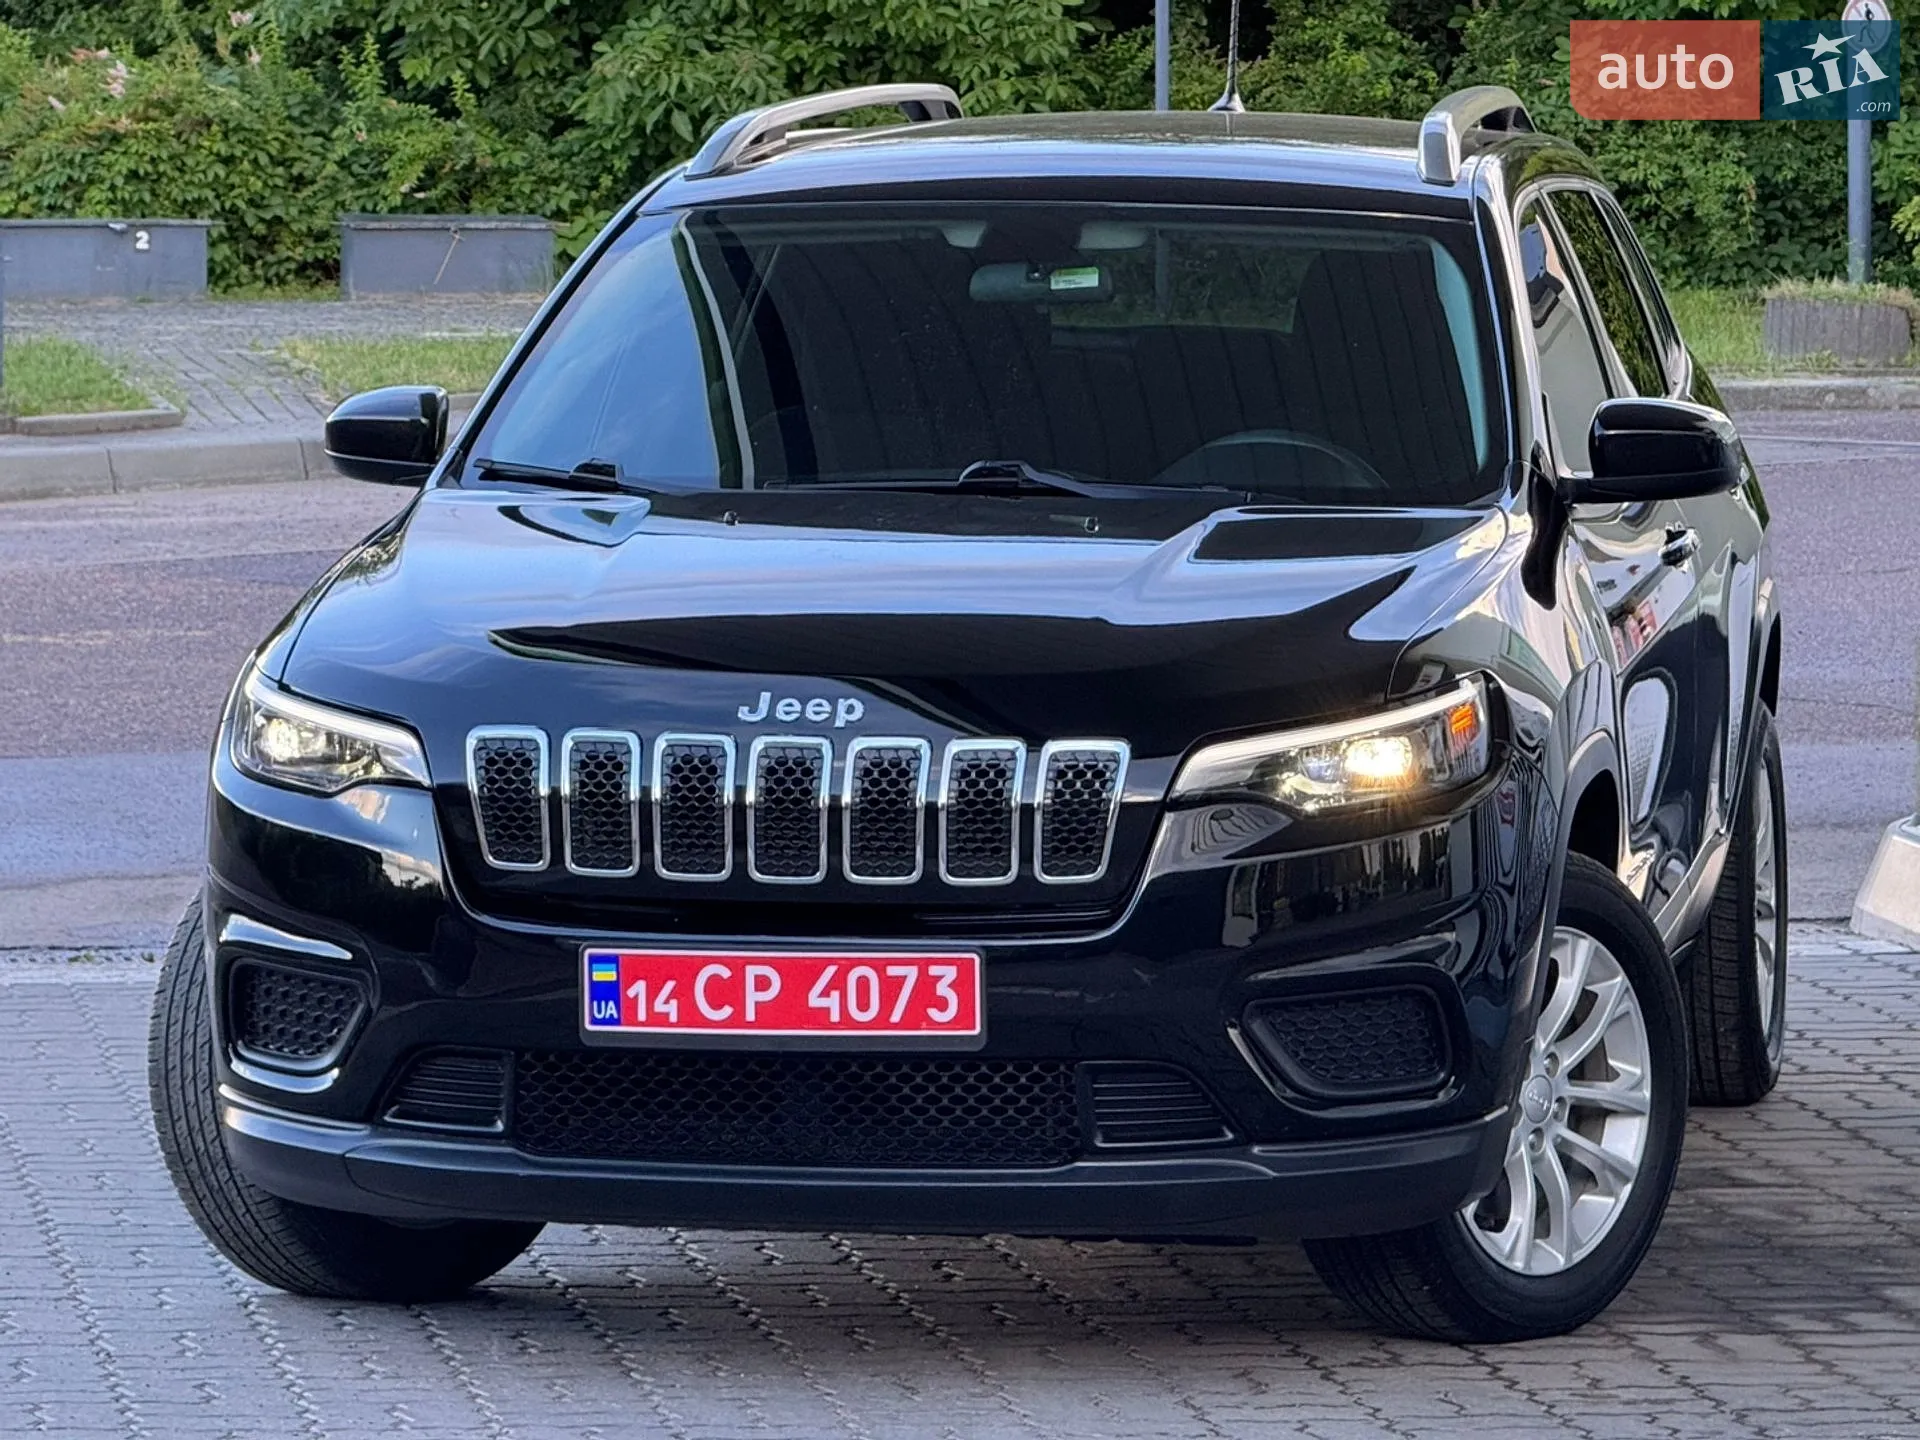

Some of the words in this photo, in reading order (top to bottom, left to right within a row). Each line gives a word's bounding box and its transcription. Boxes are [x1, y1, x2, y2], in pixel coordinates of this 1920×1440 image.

[135, 230, 149, 249] 2
[737, 691, 865, 728] Jeep
[626, 979, 678, 1023] 14
[694, 963, 782, 1022] CP
[807, 964, 959, 1024] 4073
[593, 1000, 618, 1019] UA
